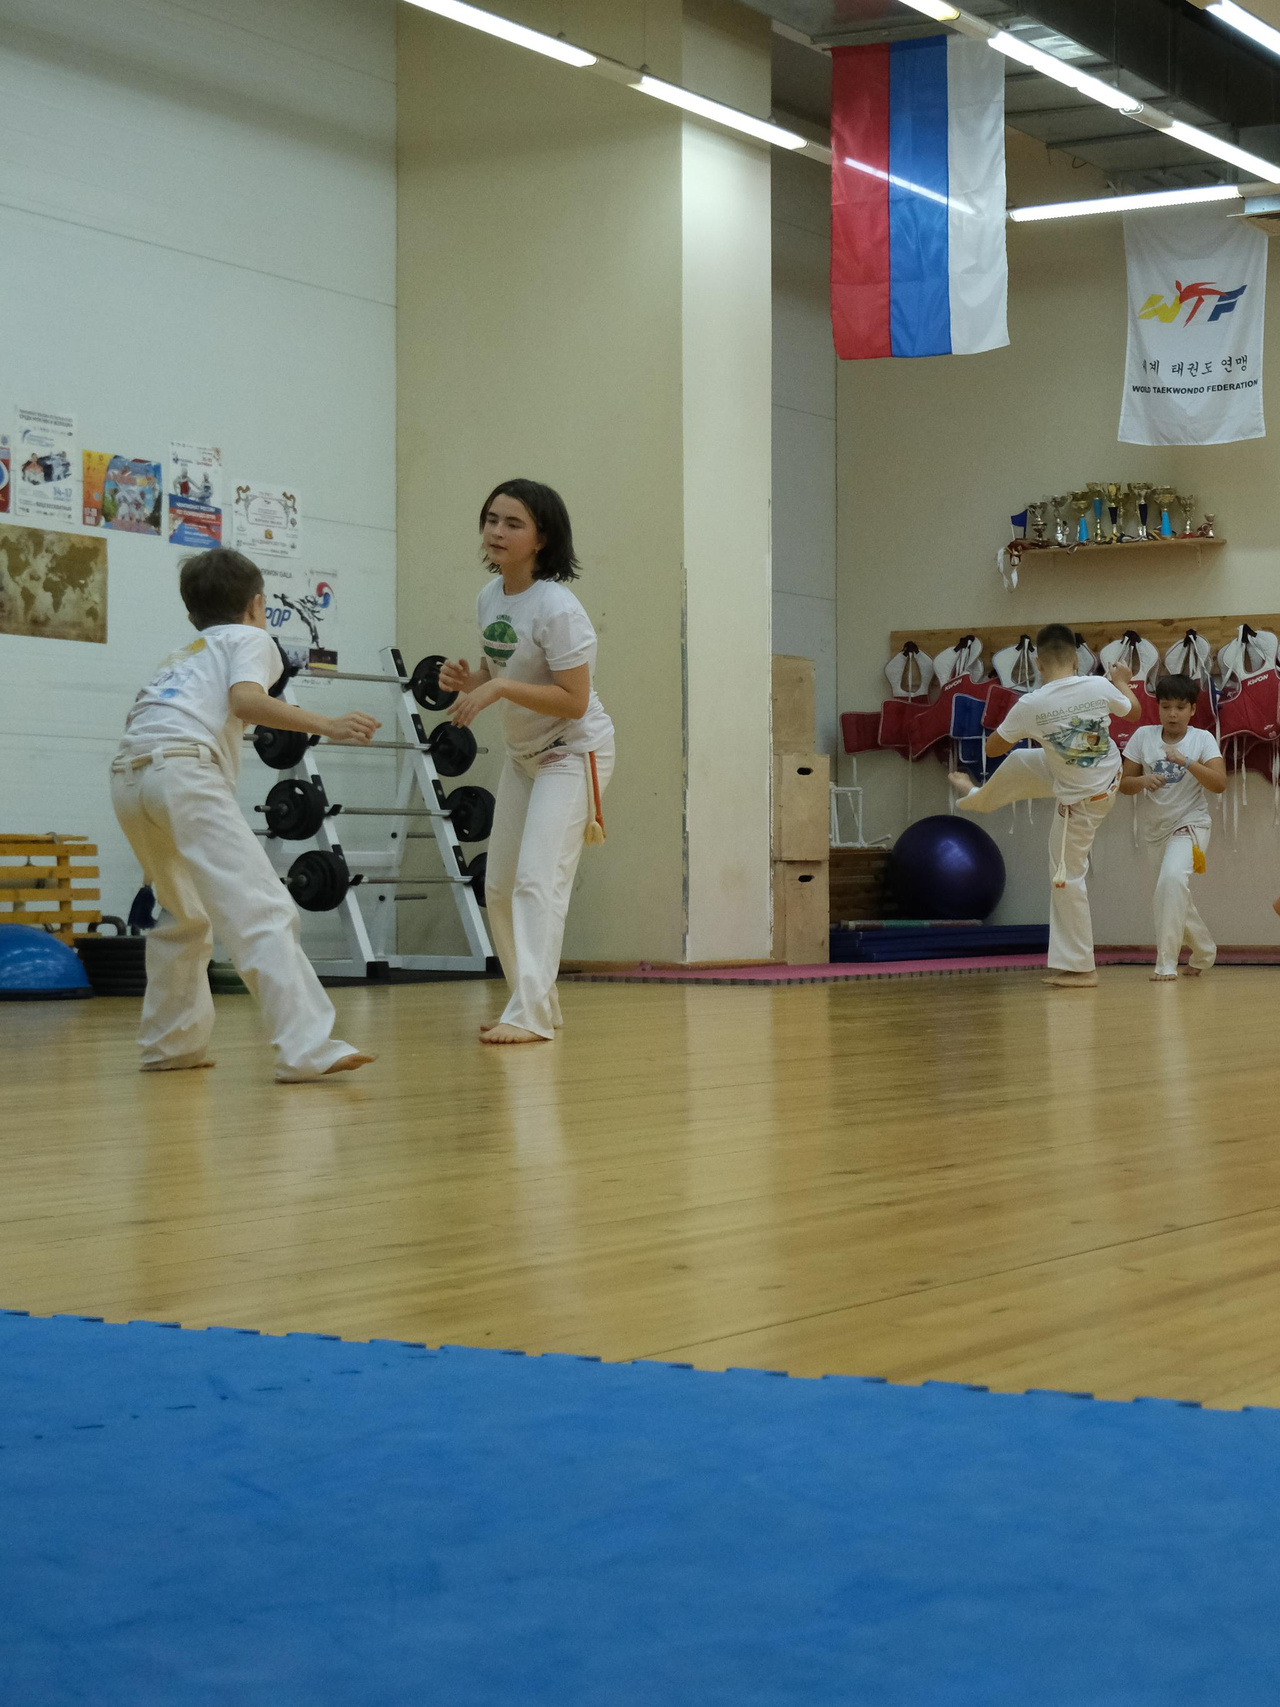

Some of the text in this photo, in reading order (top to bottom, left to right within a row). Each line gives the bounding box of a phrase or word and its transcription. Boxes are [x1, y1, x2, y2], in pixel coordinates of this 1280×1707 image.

[1138, 280, 1248, 328] WTF
[1171, 361, 1213, 378] 태권도
[1221, 354, 1248, 373] 연맹
[1152, 386, 1205, 394] TAEKWONDO
[1206, 379, 1259, 393] FEDERATION
[944, 679, 962, 692] KWON
[1247, 674, 1269, 686] KWON
